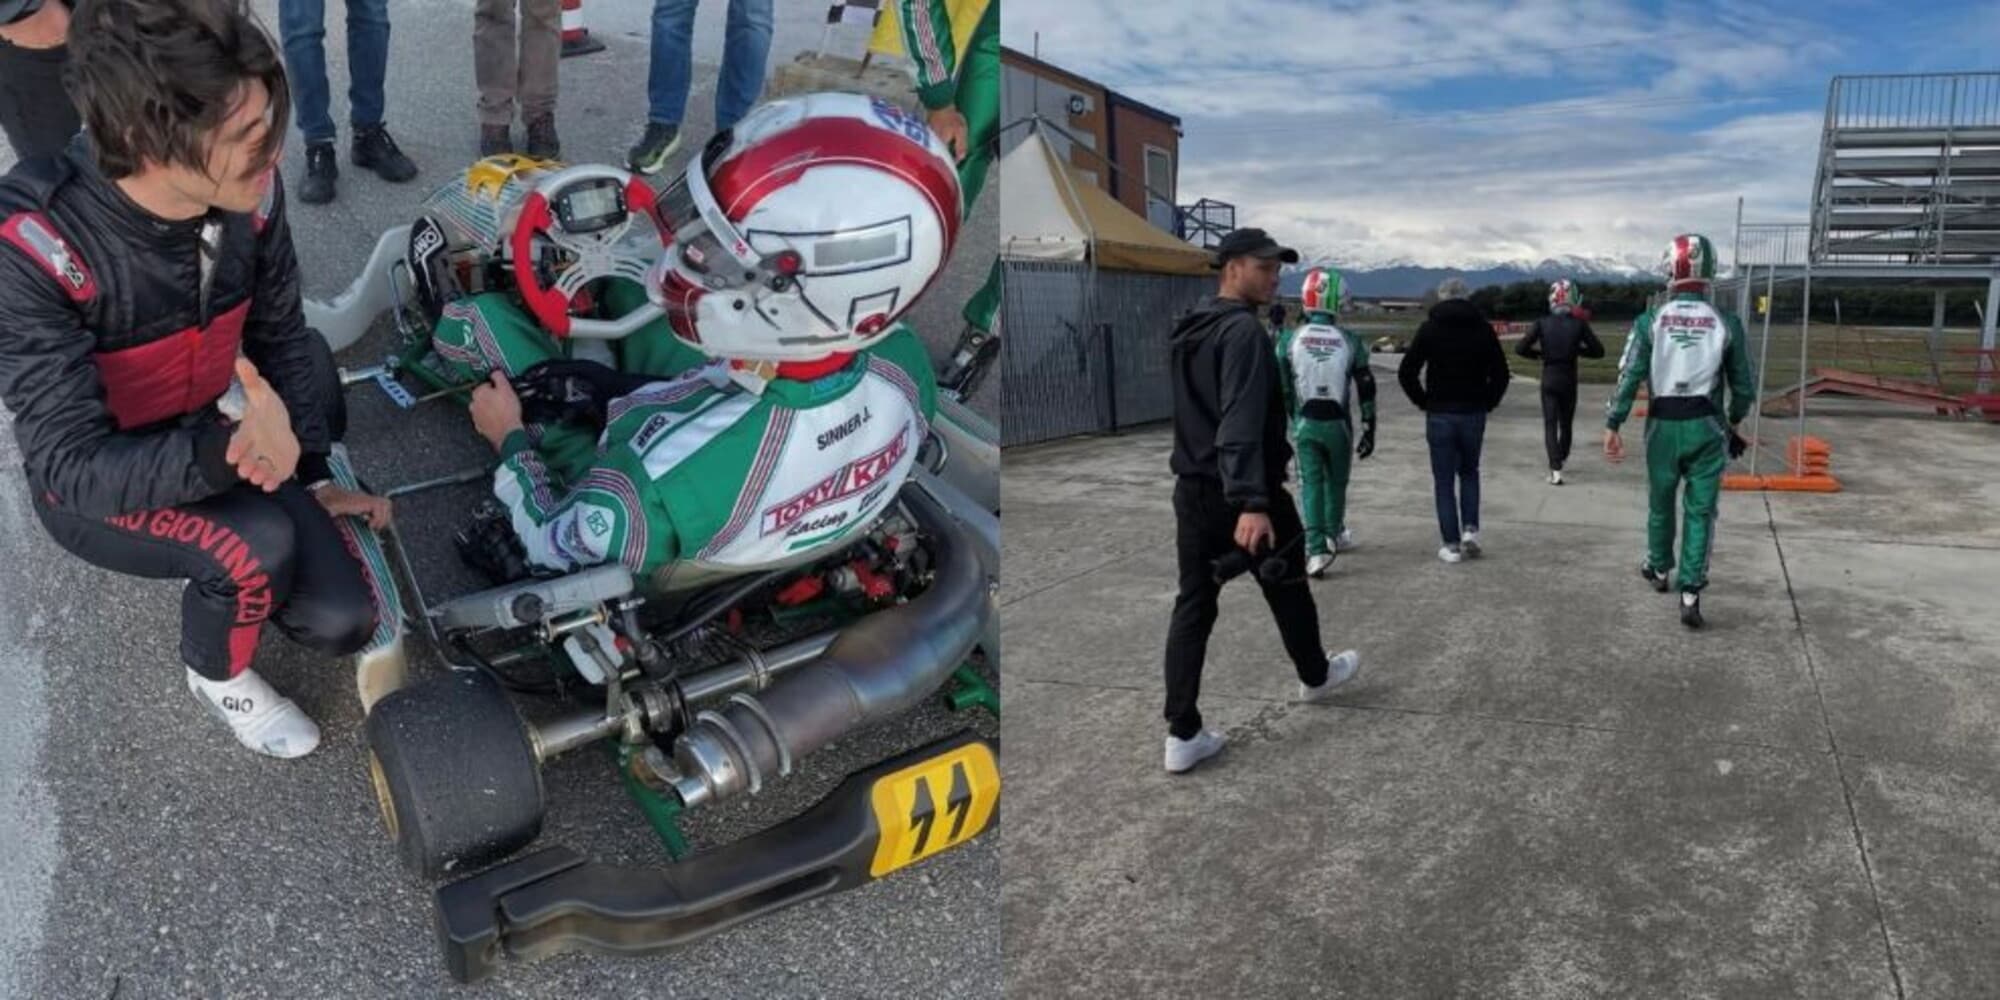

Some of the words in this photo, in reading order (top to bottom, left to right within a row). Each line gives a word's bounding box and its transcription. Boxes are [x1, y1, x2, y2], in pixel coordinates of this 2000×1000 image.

[816, 414, 861, 451] SINNER
[767, 477, 835, 530] TONY
[221, 695, 254, 714] GIO
